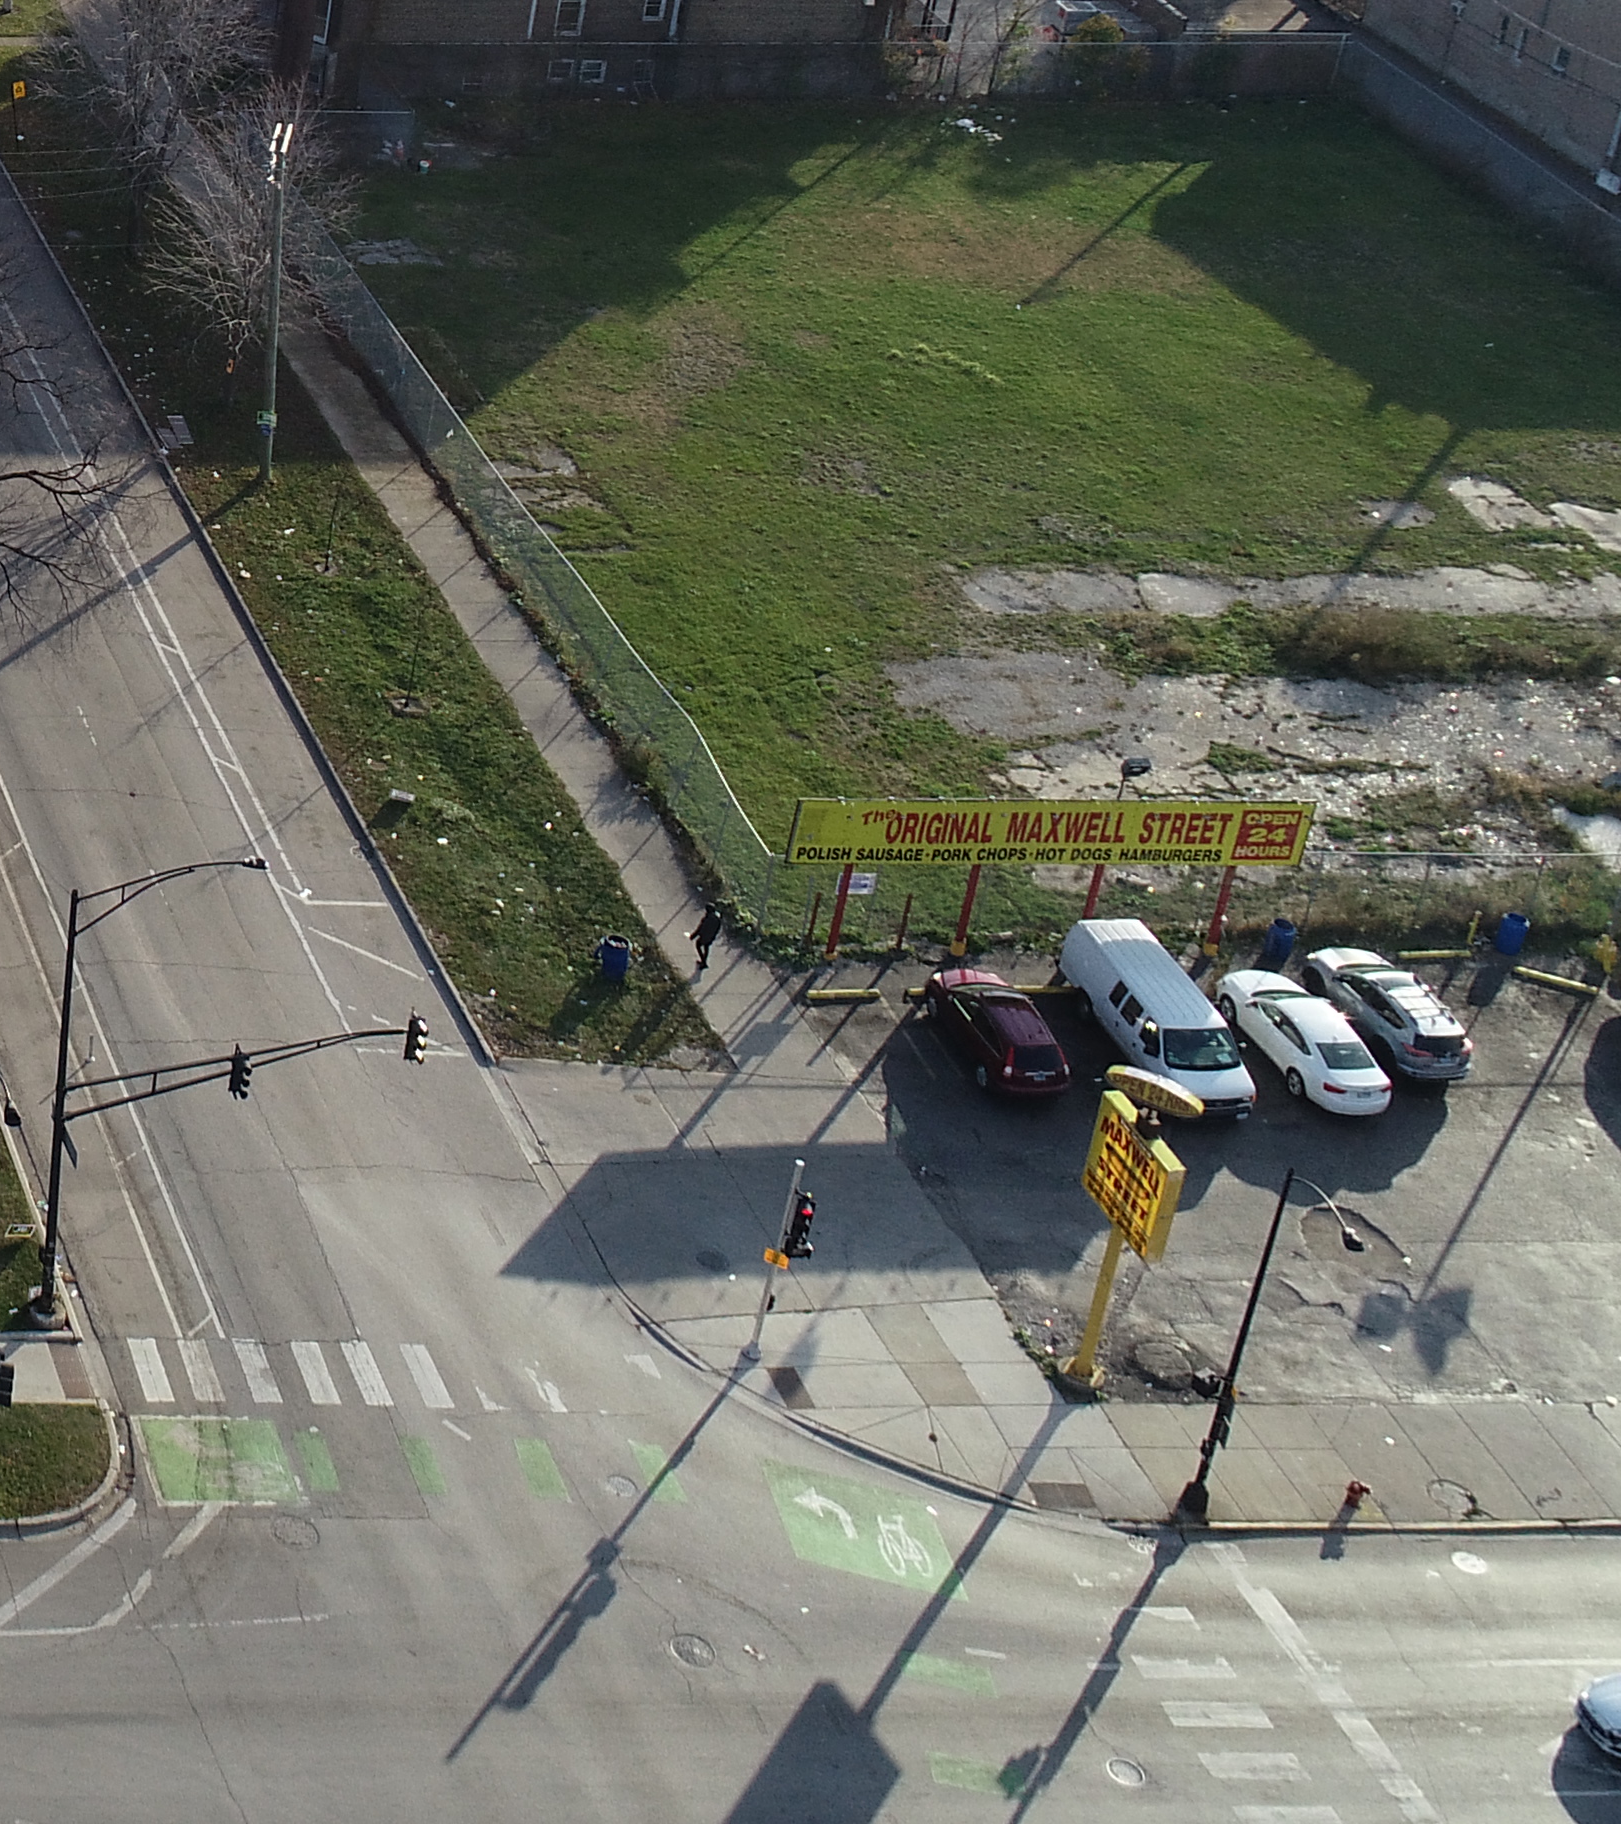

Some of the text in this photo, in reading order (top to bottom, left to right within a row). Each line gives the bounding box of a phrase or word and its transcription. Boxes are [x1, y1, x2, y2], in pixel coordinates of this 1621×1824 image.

[861, 809, 1234, 845] The ORIGINAL MAXWELL STREET
[1245, 813, 1299, 826] OPEN
[1247, 828, 1289, 844] 24
[796, 847, 1223, 863] POLISH SAUSAGE PORK CHOPS HOT DOGS HAMBURGERS
[1234, 845, 1291, 858] HOURS
[1112, 1074, 1145, 1097] OPEN
[1100, 1115, 1161, 1200] MAXWELL
[1097, 1155, 1148, 1221] STREET
